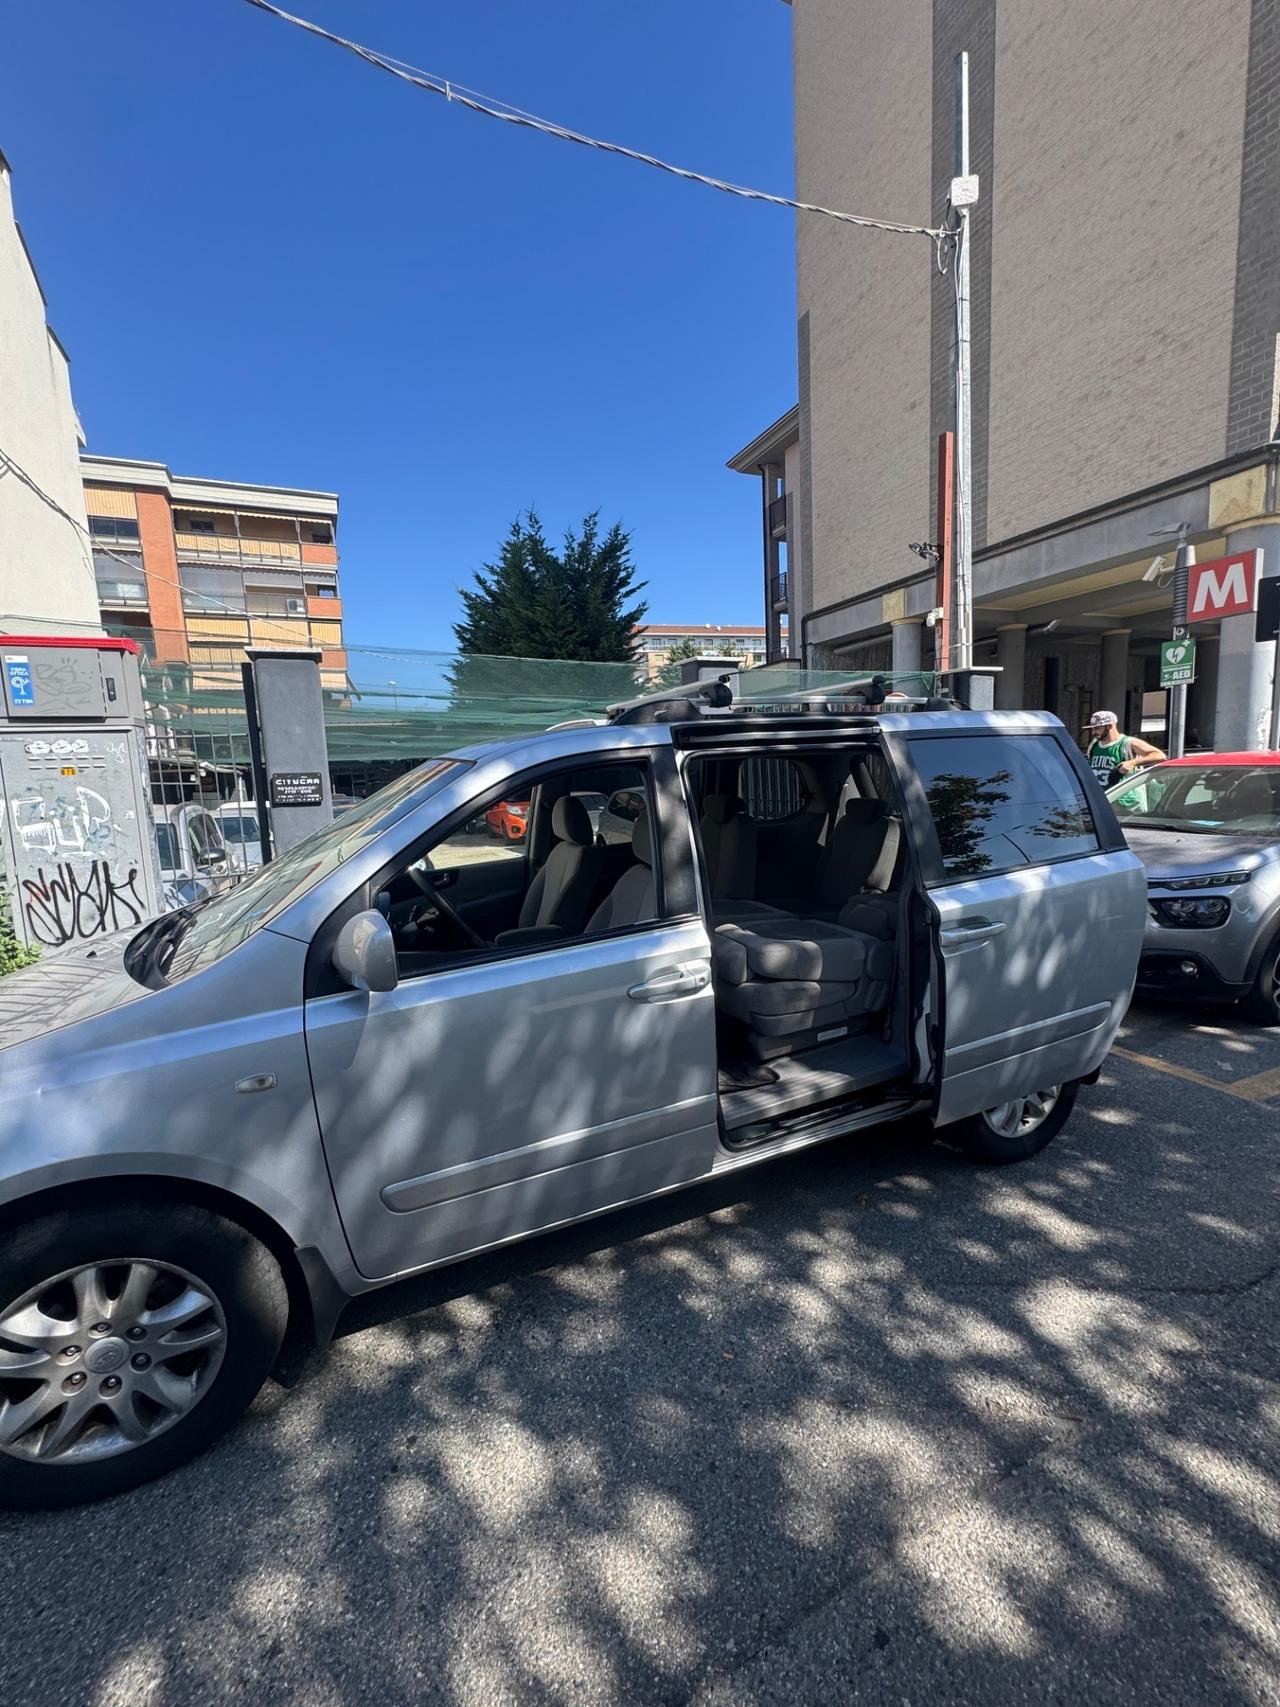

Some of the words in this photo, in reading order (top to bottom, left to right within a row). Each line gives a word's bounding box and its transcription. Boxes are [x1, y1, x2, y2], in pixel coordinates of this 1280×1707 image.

[1192, 562, 1248, 613] M
[1172, 669, 1191, 680] AED
[1090, 756, 1116, 769] ELTICS
